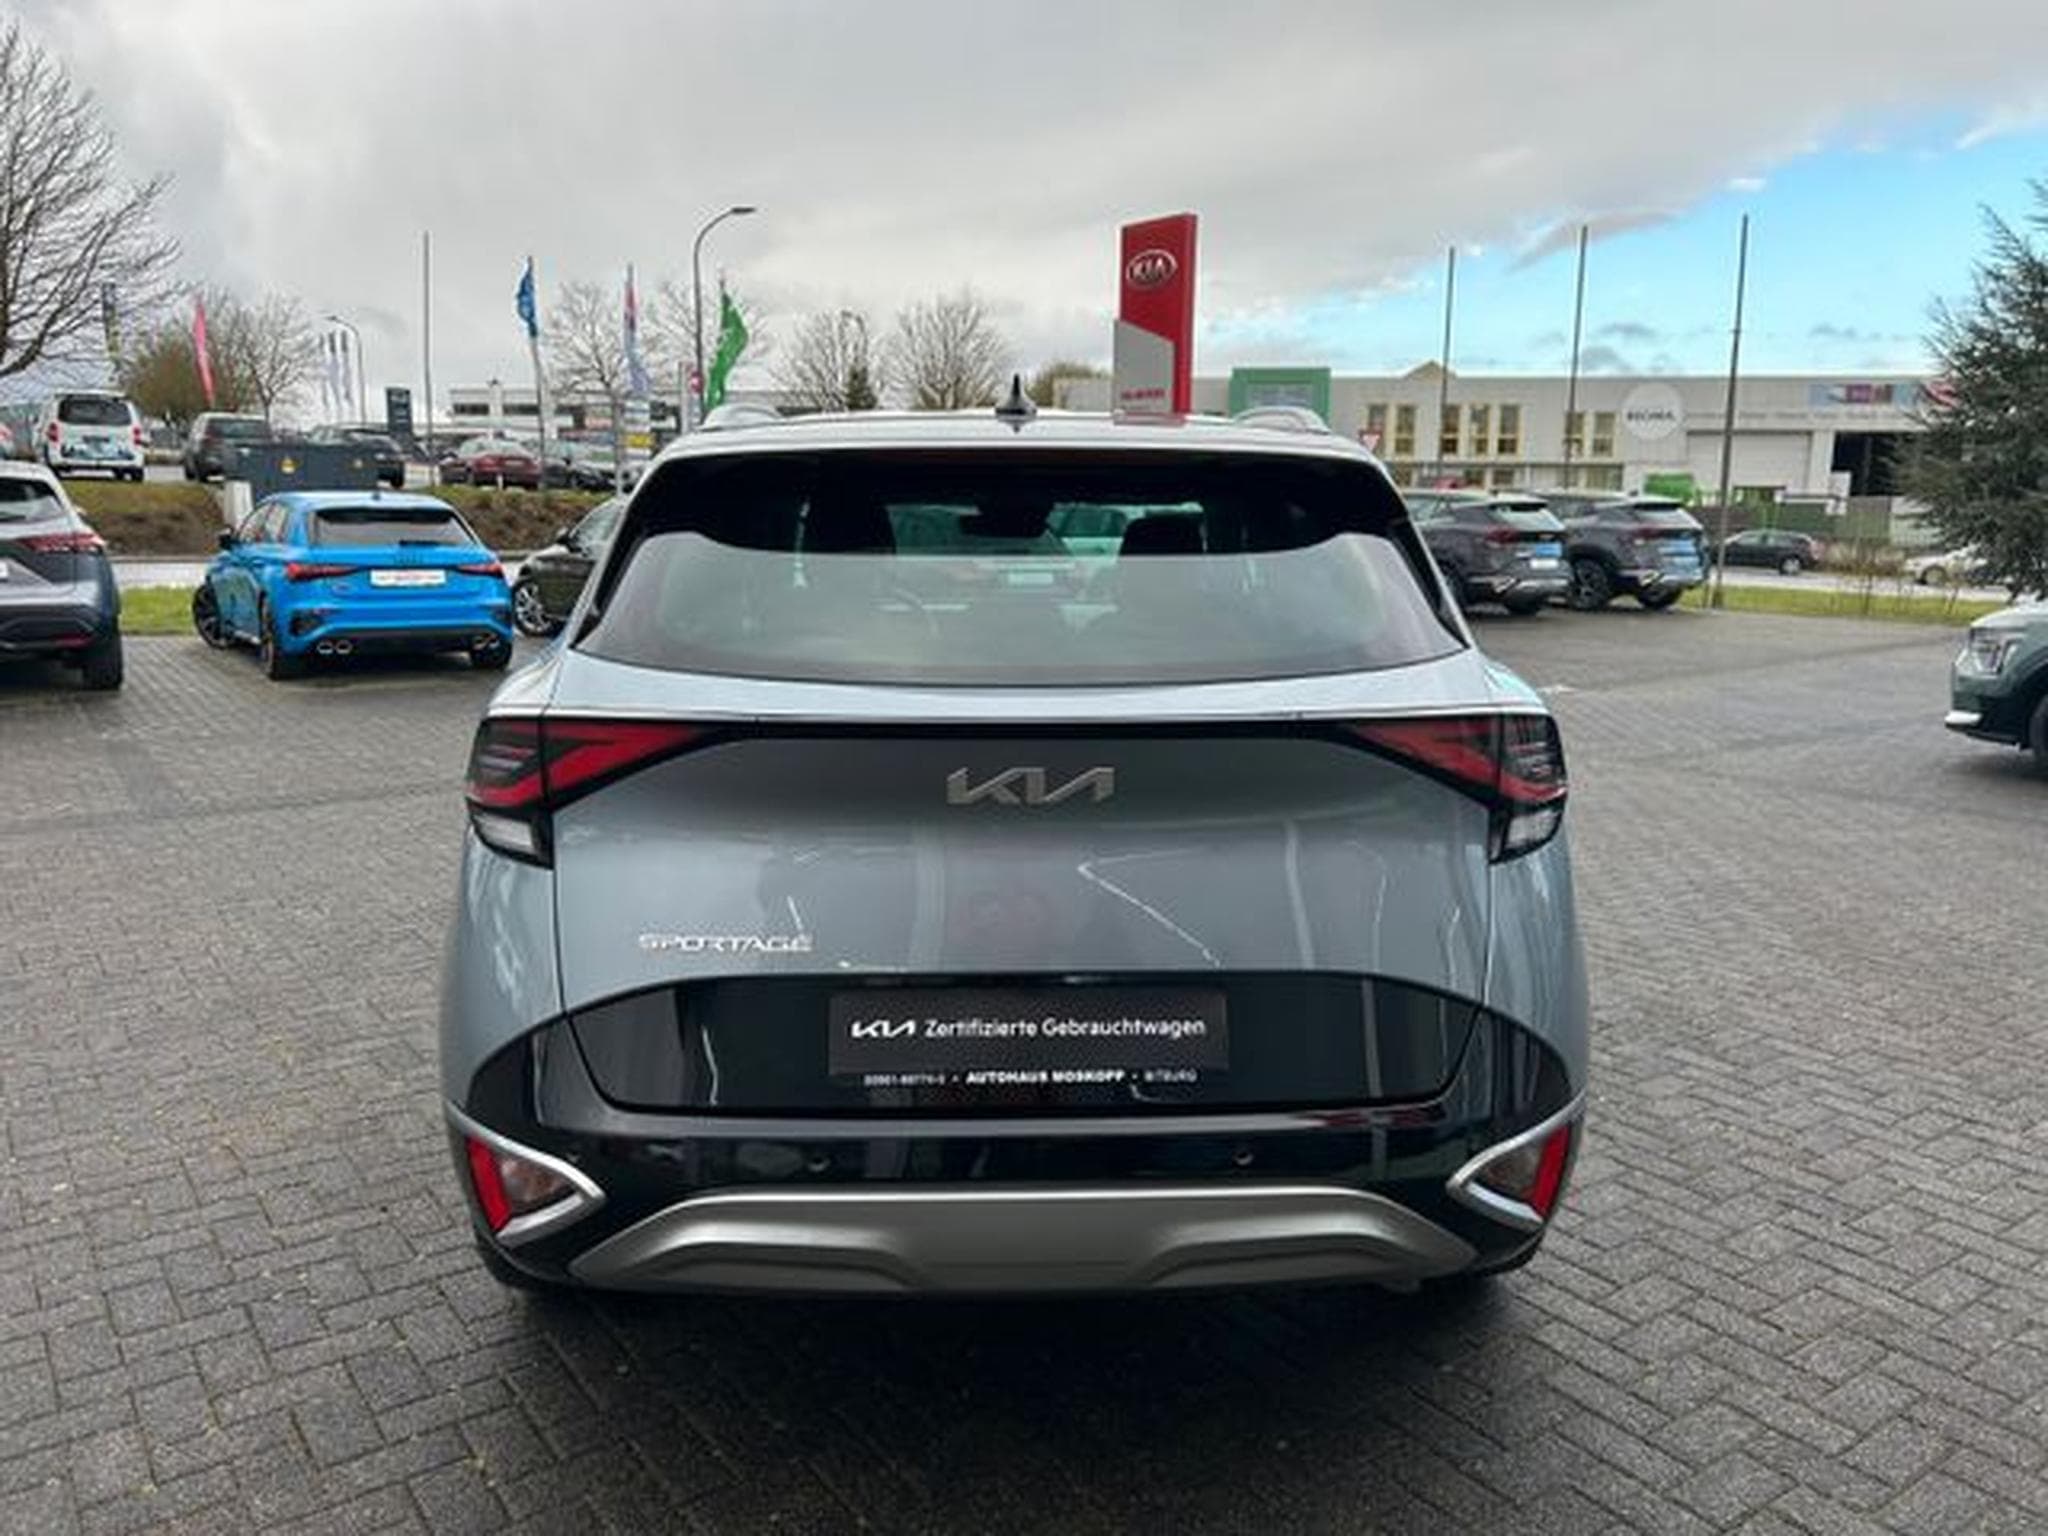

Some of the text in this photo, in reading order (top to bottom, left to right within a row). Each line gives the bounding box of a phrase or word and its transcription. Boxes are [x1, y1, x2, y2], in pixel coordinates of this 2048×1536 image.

[1131, 256, 1170, 283] KIA
[947, 767, 1115, 805] KIA
[638, 932, 814, 953] SPORTAGE
[850, 1017, 1206, 1040] KIA Zertifizierte Gebrauchtwagen
[965, 1070, 1049, 1085] AUTOHAUS
